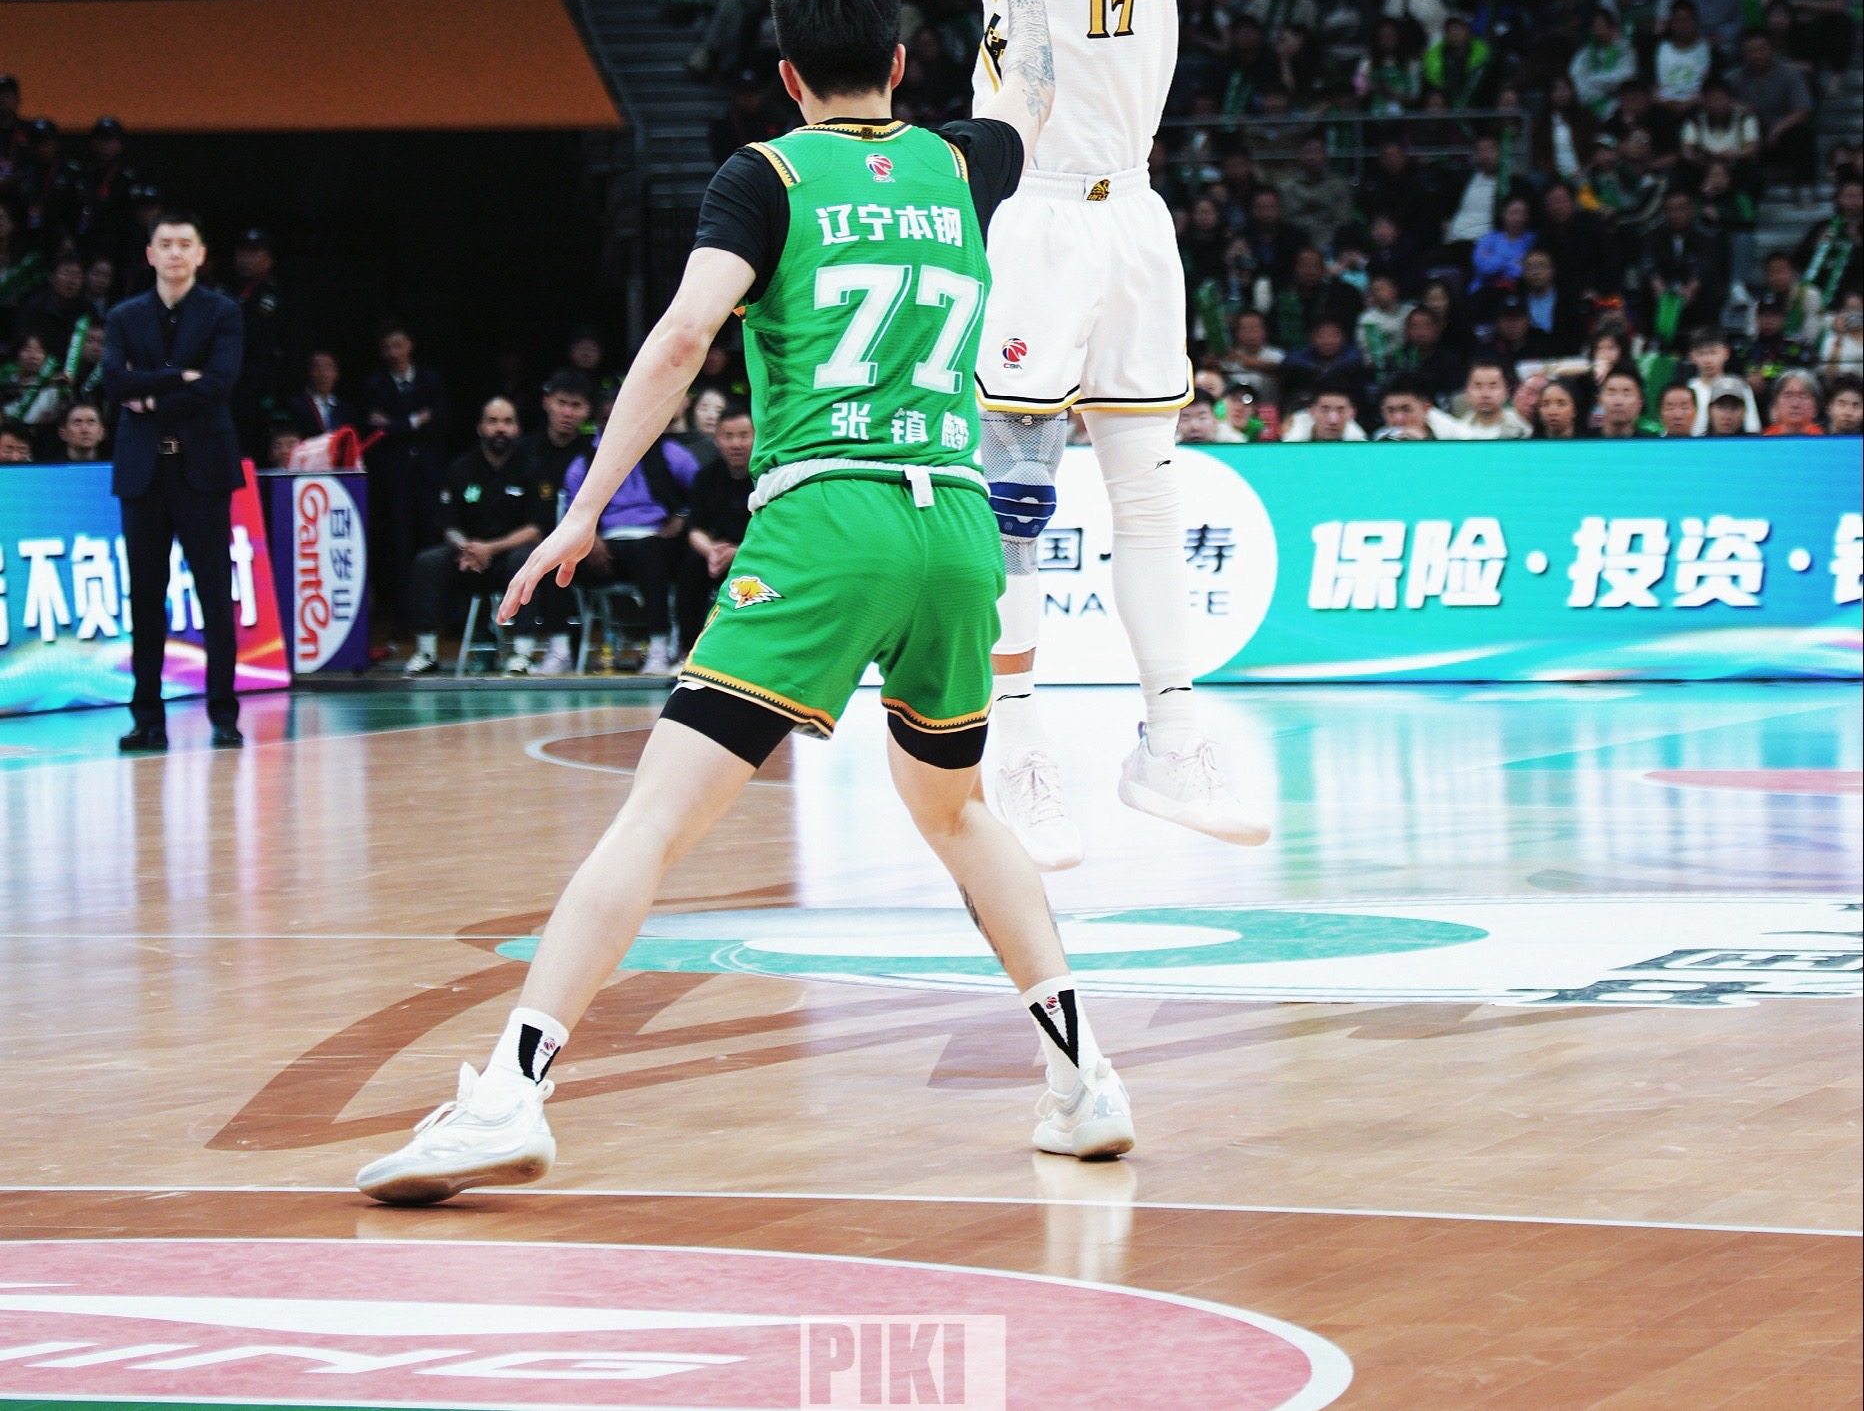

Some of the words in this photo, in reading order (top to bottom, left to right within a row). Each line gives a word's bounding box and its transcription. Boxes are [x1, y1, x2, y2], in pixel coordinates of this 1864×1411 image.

[815, 203, 963, 247] 辽宁本钢
[813, 263, 985, 394] 77
